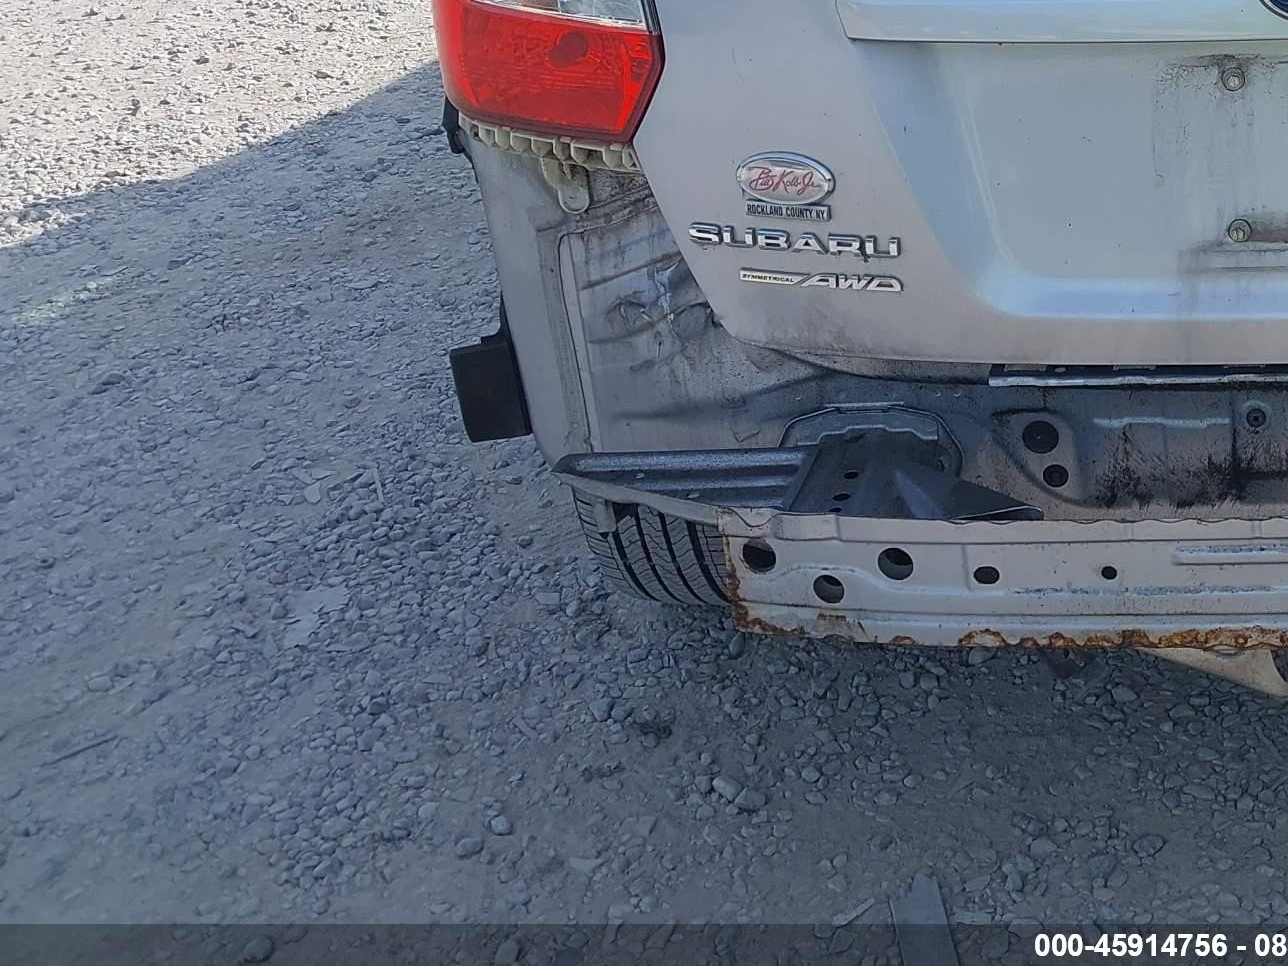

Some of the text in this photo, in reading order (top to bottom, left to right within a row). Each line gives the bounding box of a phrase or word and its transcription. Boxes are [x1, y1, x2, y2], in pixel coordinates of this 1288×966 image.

[746, 204, 826, 220] ROCKLAND COUNTY NY
[688, 222, 901, 259] SUBARU
[742, 272, 904, 292] SYMMETRICAL AWD
